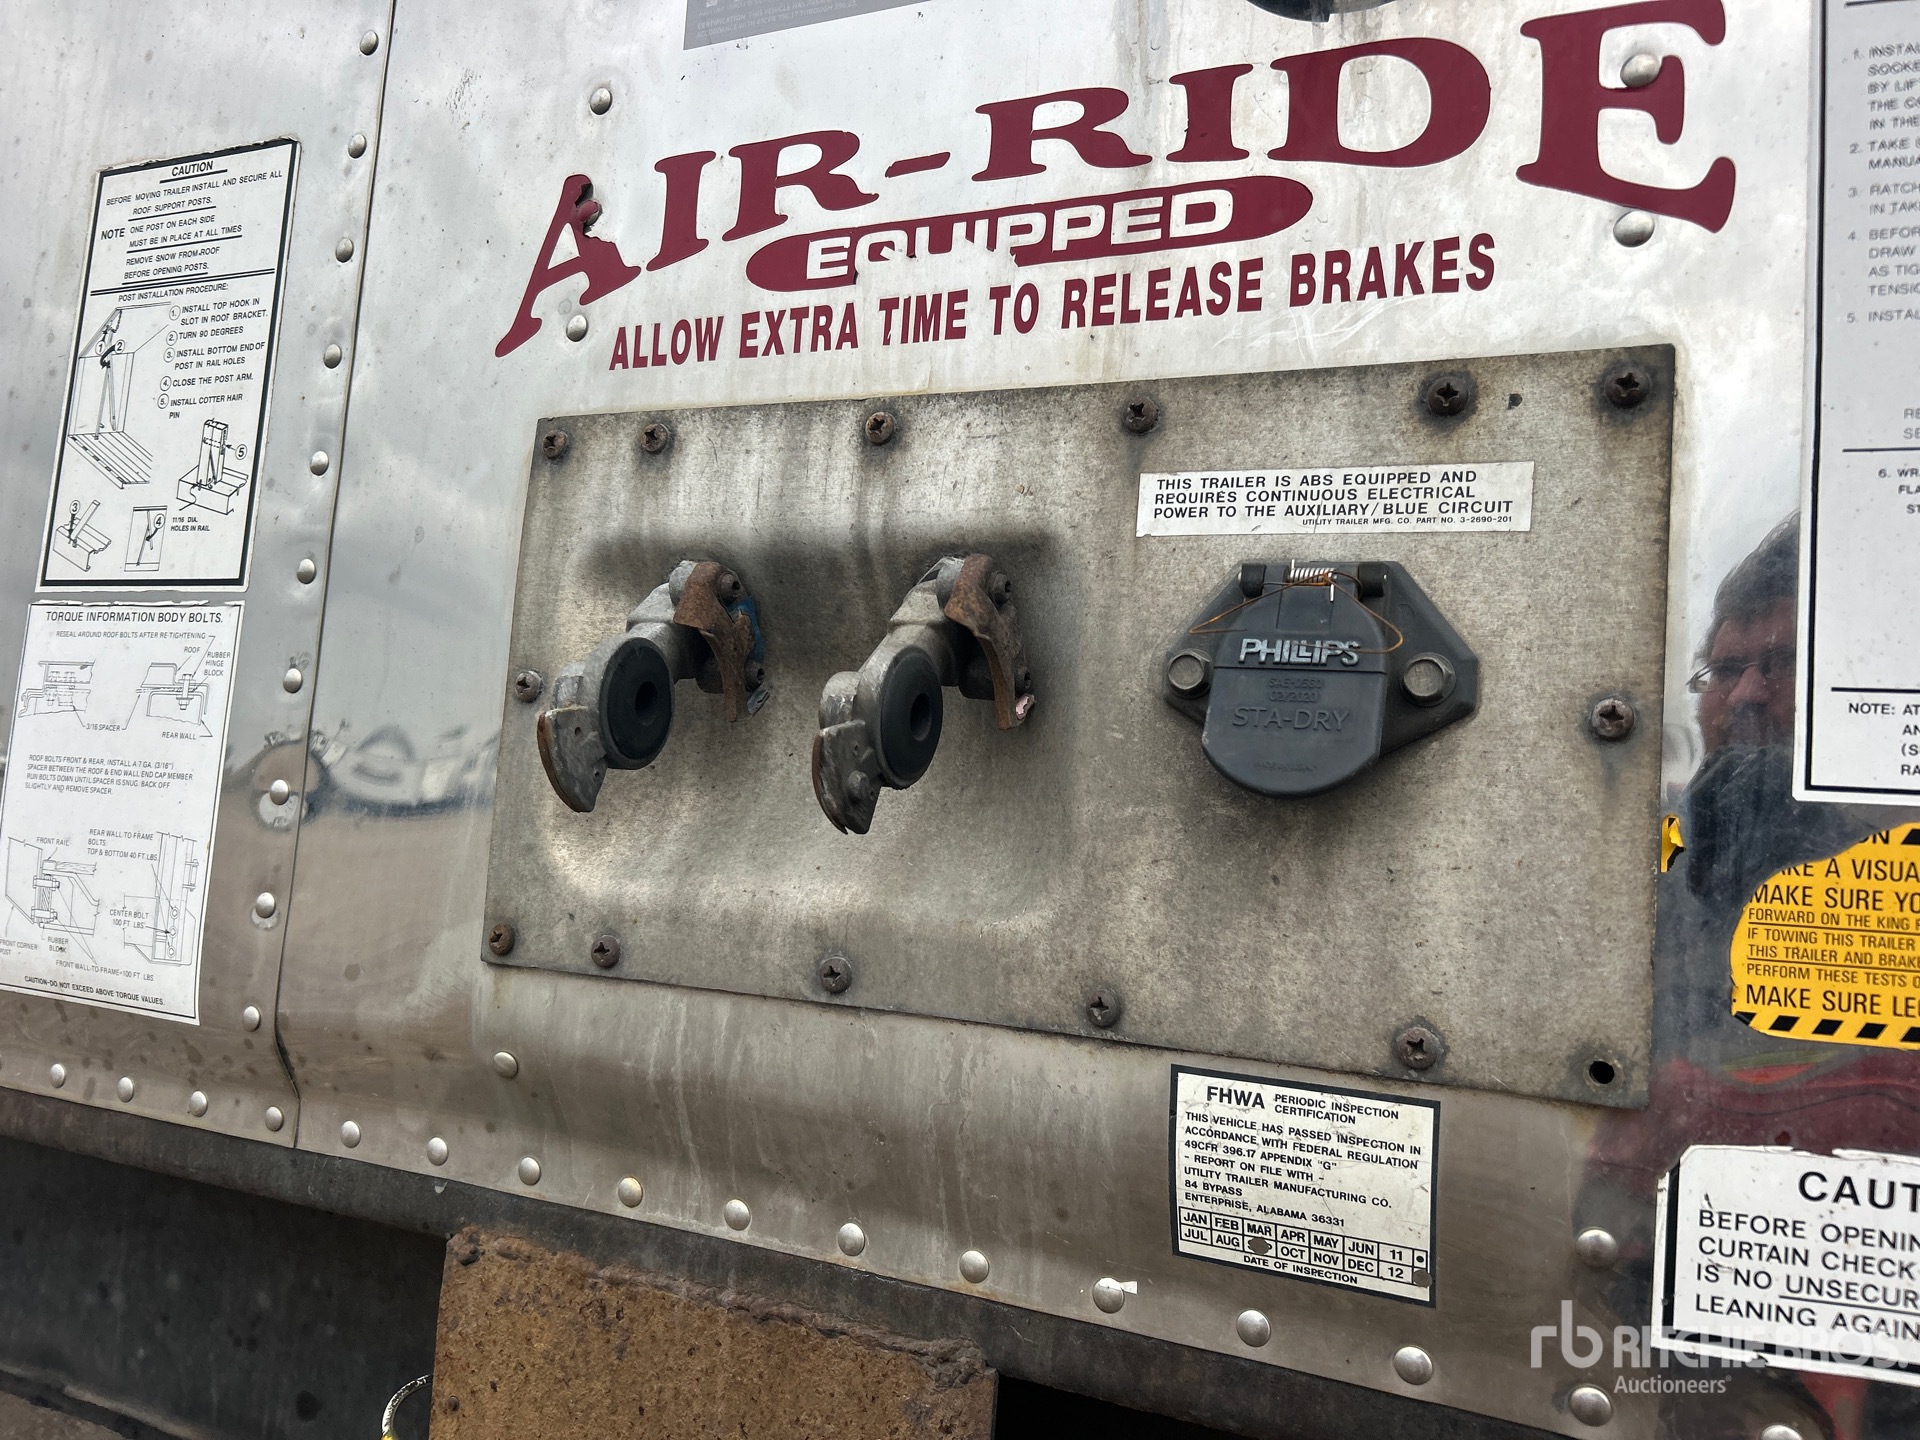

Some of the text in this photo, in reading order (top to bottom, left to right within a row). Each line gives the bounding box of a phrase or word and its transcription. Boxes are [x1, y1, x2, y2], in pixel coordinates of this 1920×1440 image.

[172, 160, 213, 177] CAUTION
[495, 0, 1736, 358] AIR-RIDE
[106, 170, 282, 206] BEFORE MOVING TRAILER INSTALL AND SECURE ALL
[133, 196, 212, 215] ROOF SUPPORT POSTS.
[101, 228, 125, 240] NOTE
[130, 225, 144, 234] ONE
[146, 222, 164, 231] POST
[178, 217, 197, 227] EACH
[199, 215, 215, 224] SIDE
[806, 189, 1233, 280] EQUIPPED
[124, 262, 209, 279] BEFORE OPENING POSTS.
[118, 293, 136, 302] POST
[138, 288, 184, 300] INSTALLATION
[182, 304, 210, 313] INSTALL
[213, 301, 227, 310] TOP
[229, 299, 250, 308] HOOK
[609, 233, 1495, 371] ALLOW EXTRA TIME TO RELEASE BRAKES
[179, 326, 244, 339] TURN 90 DEGREES
[1157, 470, 1477, 490] THIS TRAILER IS ABS EQUIPPED AND
[1155, 486, 1475, 505] REQUIRES CONTINUOUS ELECTRICAL
[1154, 506, 1208, 519] POWER
[1217, 506, 1236, 517] TO
[1245, 505, 1276, 517] THE
[1438, 500, 1513, 514] CIRCUIT
[46, 611, 223, 623] TORQUE INFORMATION BODY BOLTS.
[1239, 638, 1361, 667] PHILLIPS
[1232, 707, 1350, 731] STA-DRY
[1849, 702, 1895, 715] NOTE:
[1825, 858, 1841, 878] A
[1751, 883, 1813, 907] MAKE
[1824, 887, 1883, 911] SURE
[1749, 908, 1910, 930] FORWARD ON THE KING
[1748, 927, 1915, 951] IF TOWING THIS TRAILER
[1748, 944, 1777, 958] THIS
[1783, 946, 1838, 963] TRAILER
[1843, 951, 1873, 965] AND
[1747, 963, 1907, 987] PERFORM THESE TESTS
[1746, 984, 1881, 1015] MAKE SURE
[1206, 1086, 1265, 1109] FHWA
[1274, 1094, 1399, 1120] PERIODIC INSPECTION
[1275, 1104, 1356, 1124] CERTIFICATION
[1185, 1111, 1421, 1155] THIS VEHICLE HAS PASSED INSPECTION IN
[1184, 1140, 1337, 1170] 49CFR 396.17 APPENDIX "G"
[1185, 1126, 1419, 1170] ACCORDANCE WITH FEDERAL REGULATION
[1194, 1154, 1313, 1182] REPORT ON FILE WITH
[1184, 1166, 1391, 1208] UTILITY TRAILER MANUFACTURING CO.
[1185, 1179, 1242, 1196] 84 BYPASS
[1185, 1192, 1344, 1227] ENTERPRISE, ALABAMA 36331
[1699, 1209, 1806, 1239] BEFORE
[1183, 1212, 1402, 1261] JAN FEB MAR APR MAY JUN 11
[1184, 1228, 1404, 1279] JUL AUG OCT NOV DEC 12
[1699, 1236, 1915, 1280] CURTAIN CHECK
[1243, 1255, 1357, 1284] DATE OF INSPECTION
[1697, 1263, 1719, 1283] IS
[1733, 1267, 1772, 1289] NO
[1696, 1294, 1816, 1326] LEANING
